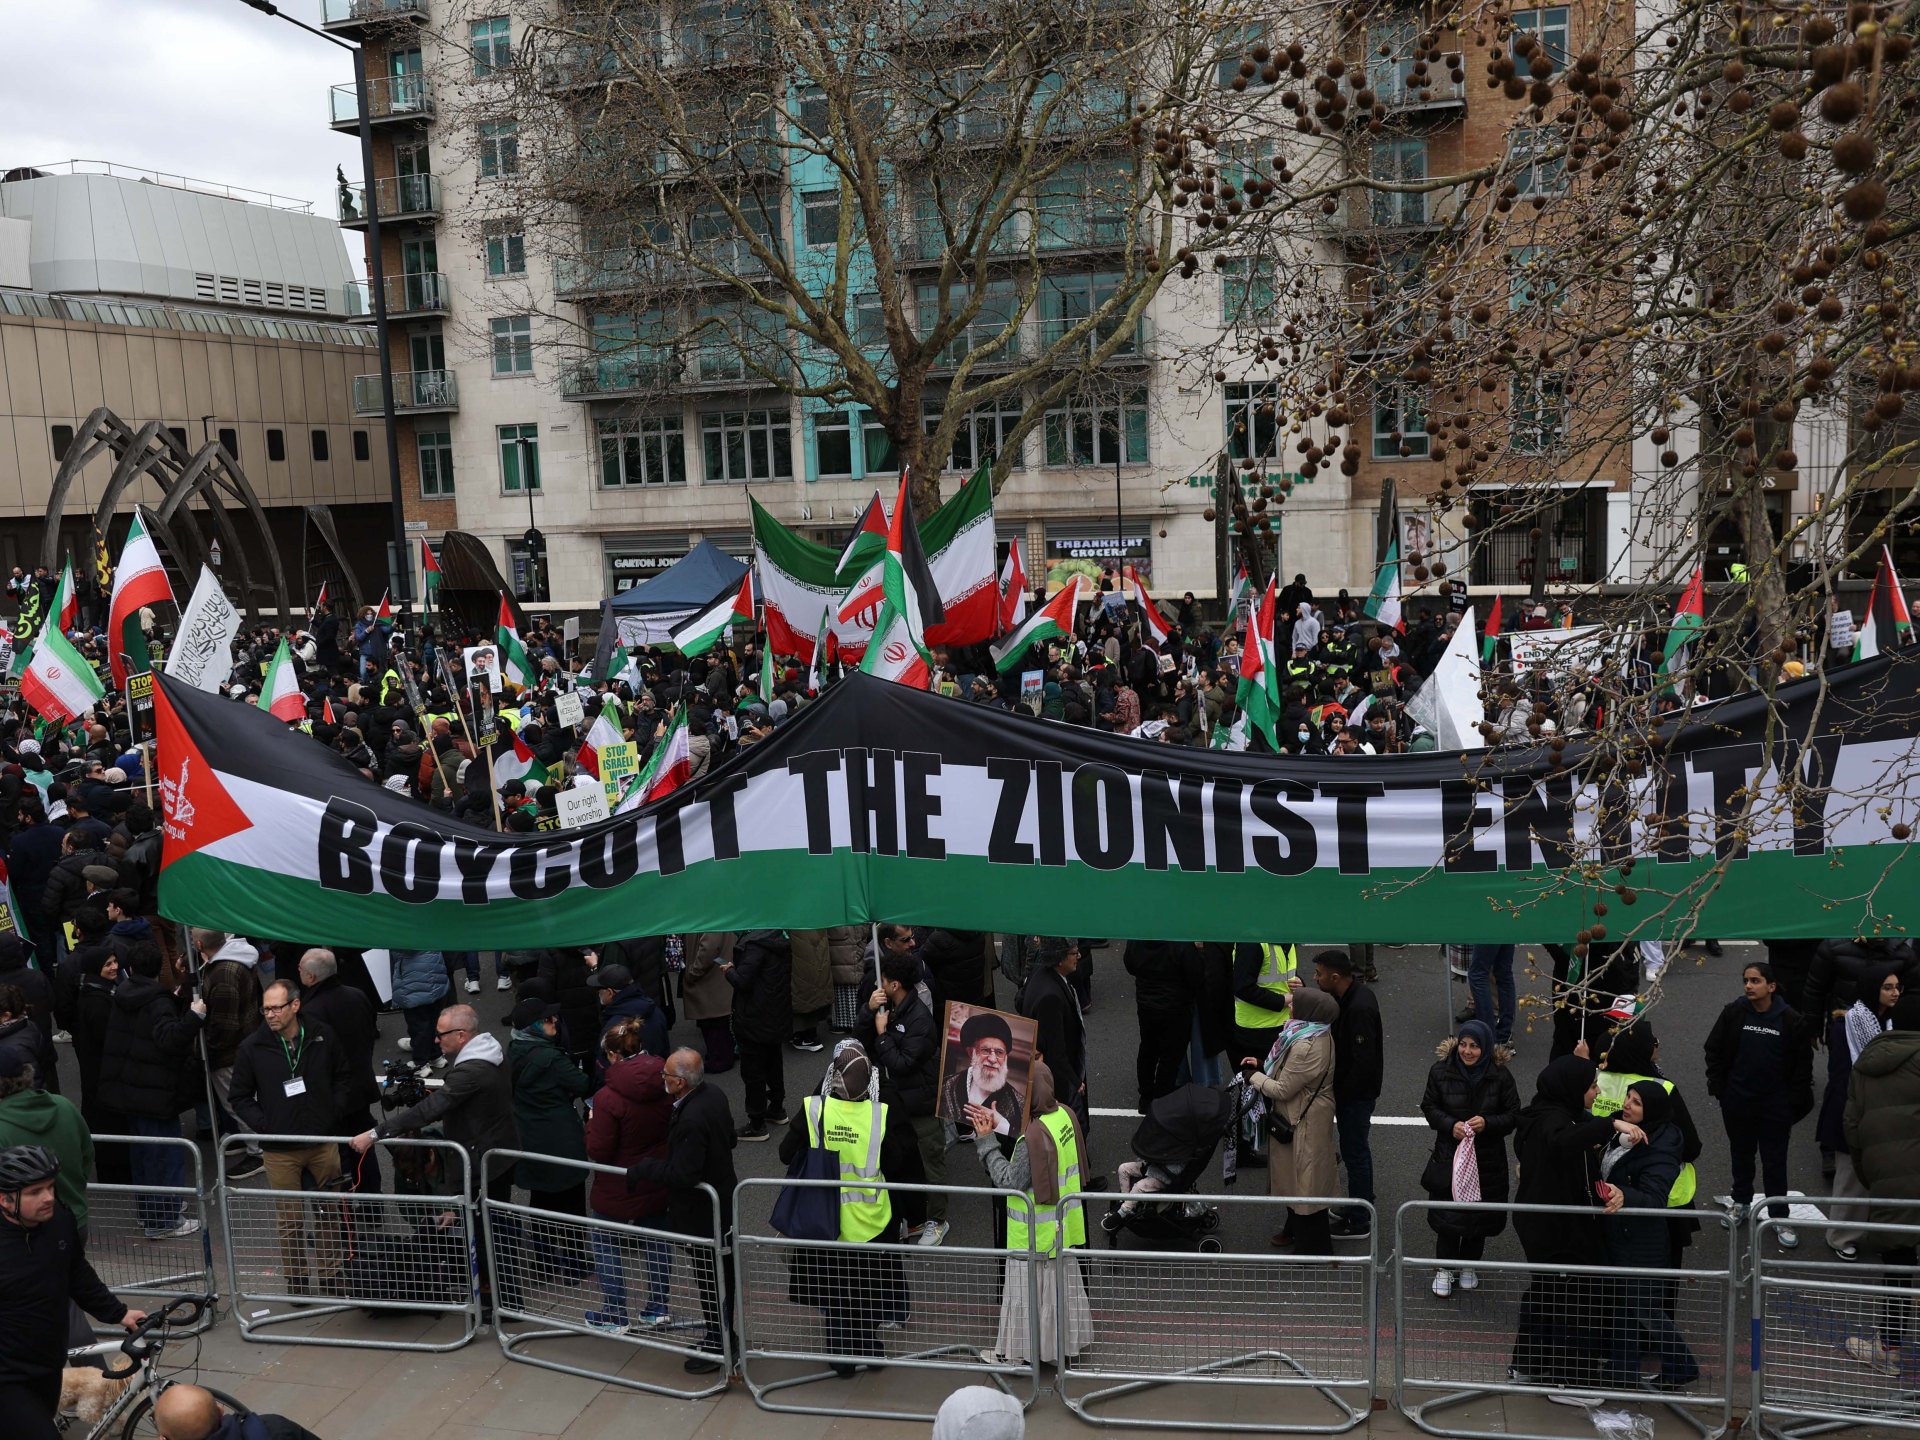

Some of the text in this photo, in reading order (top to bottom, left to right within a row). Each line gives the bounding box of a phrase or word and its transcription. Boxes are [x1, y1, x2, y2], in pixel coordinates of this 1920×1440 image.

[1055, 539, 1142, 548] EMBANKMENT
[1070, 548, 1128, 557] GROCERY
[614, 558, 655, 568] GARTON
[657, 558, 682, 567] JON
[1523, 651, 1541, 659] END
[130, 675, 153, 690] STOP
[137, 701, 153, 711] IRAN
[606, 745, 627, 757] STOP
[603, 756, 633, 770] ISRAELI
[567, 794, 598, 811] Our right
[319, 734, 1844, 905] BOYCOTT THE ZIONIST ENTITY
[567, 808, 603, 826] to worship
[537, 817, 561, 832] STO
[826, 1129, 843, 1137] Human
[834, 1124, 852, 1132] Islamic
[828, 1136, 857, 1145] Commission
